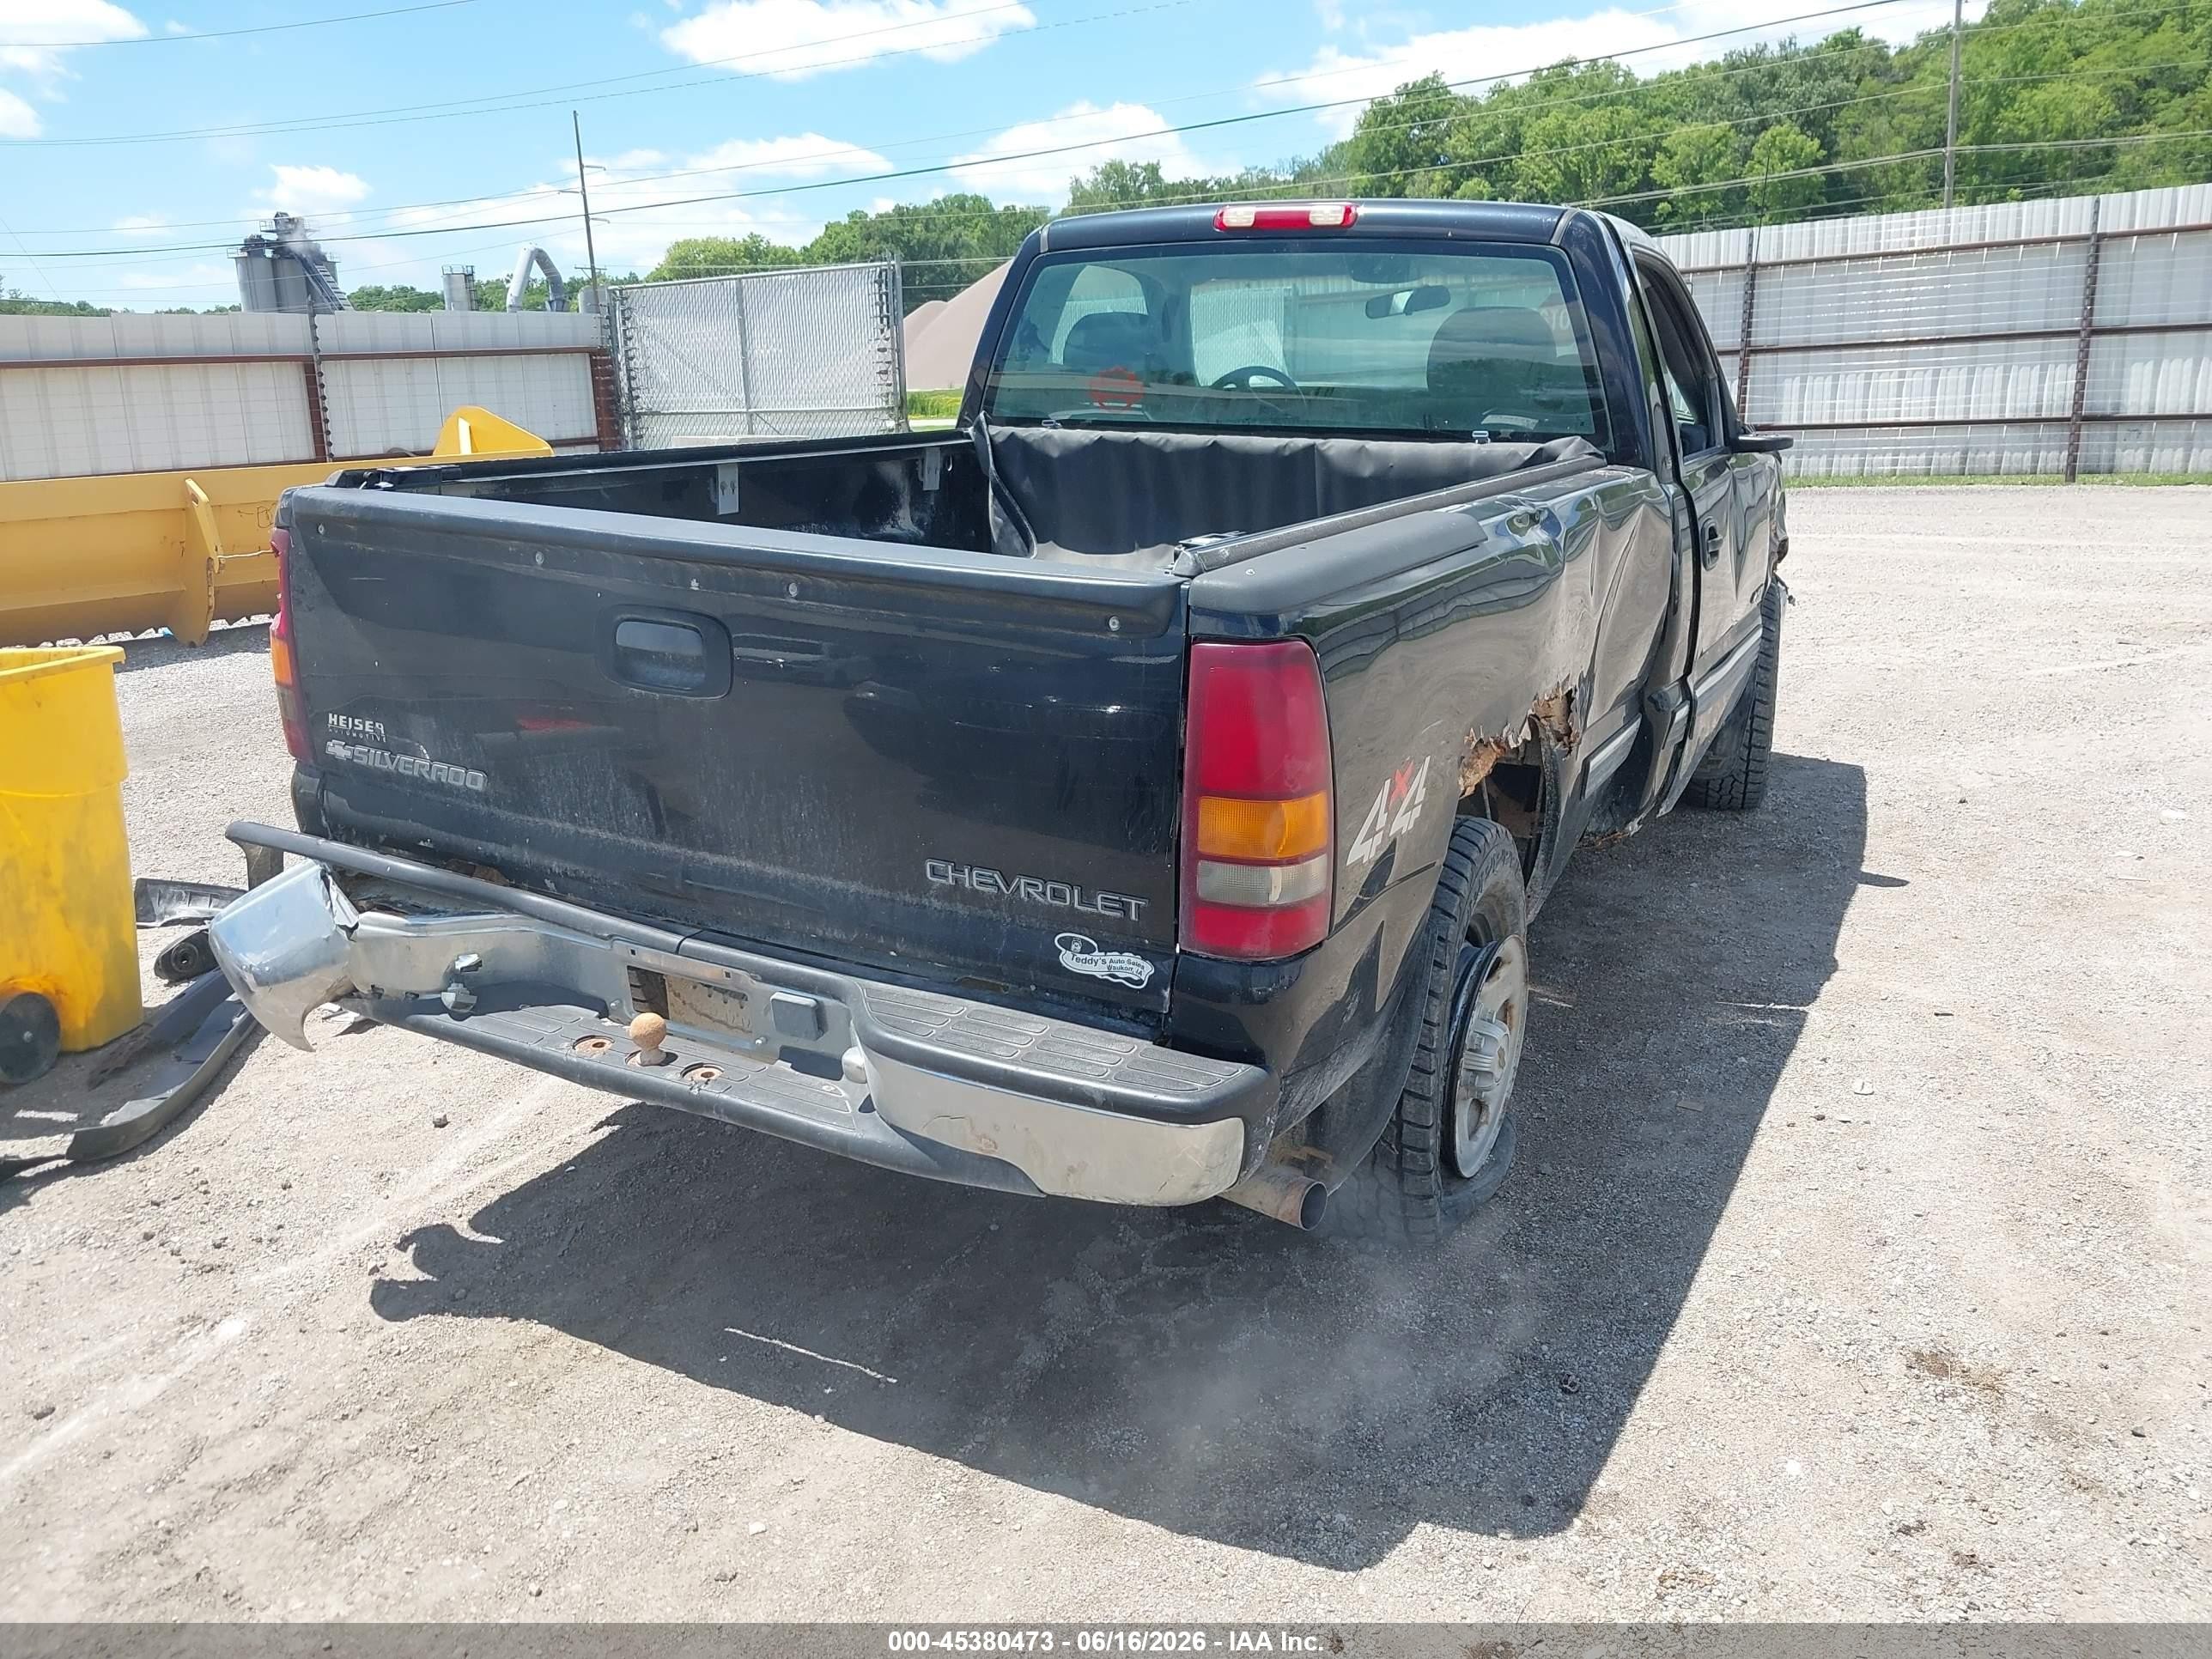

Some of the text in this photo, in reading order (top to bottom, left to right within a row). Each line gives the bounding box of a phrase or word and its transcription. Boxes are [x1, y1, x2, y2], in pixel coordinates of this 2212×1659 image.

[328, 713, 385, 734] HEISER
[352, 745, 489, 791] SILVERADO
[925, 858, 1150, 921] CHEVROLET
[1070, 953, 1107, 967] Teddy's
[1127, 958, 1145, 970] Sales
[1135, 968, 1143, 976] IA
